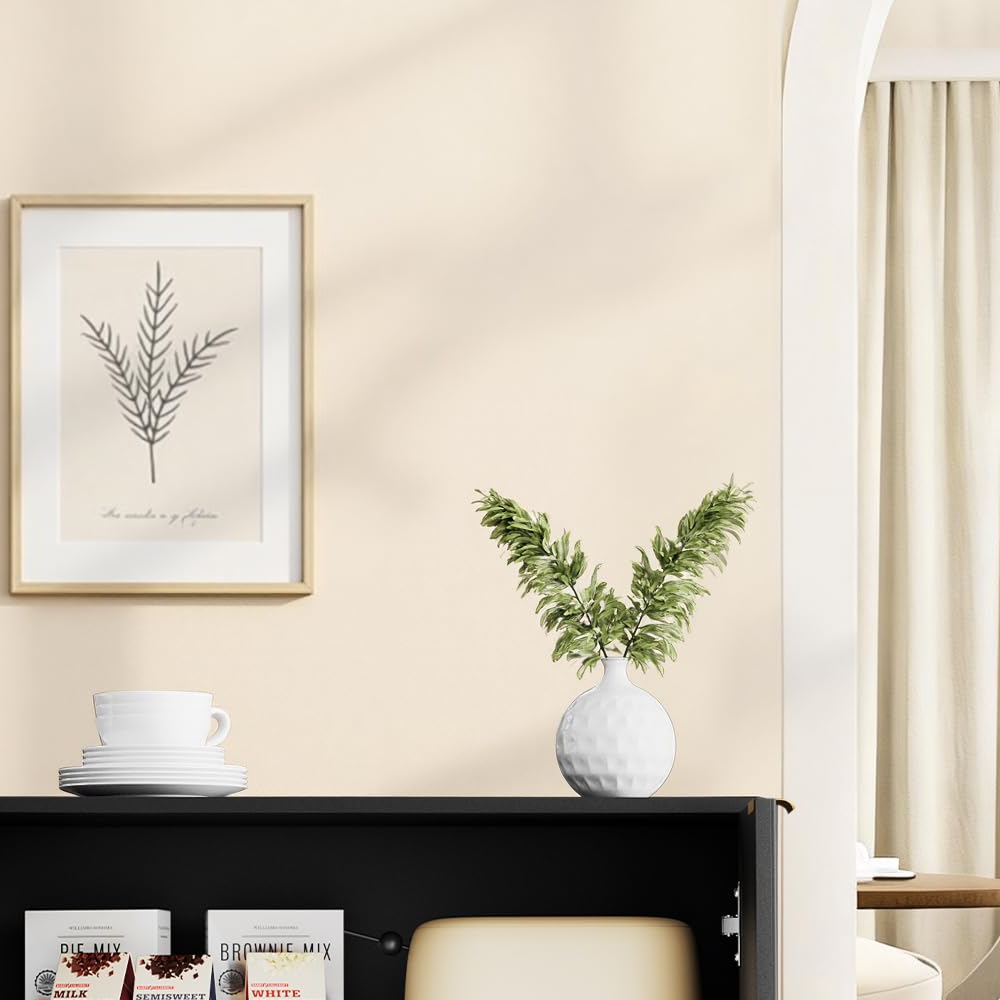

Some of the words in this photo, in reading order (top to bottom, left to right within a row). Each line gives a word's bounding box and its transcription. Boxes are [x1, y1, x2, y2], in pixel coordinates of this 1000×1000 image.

[54, 990, 88, 998] MILK
[136, 993, 206, 1000] SEMISWEET
[251, 989, 301, 998] WHITE
